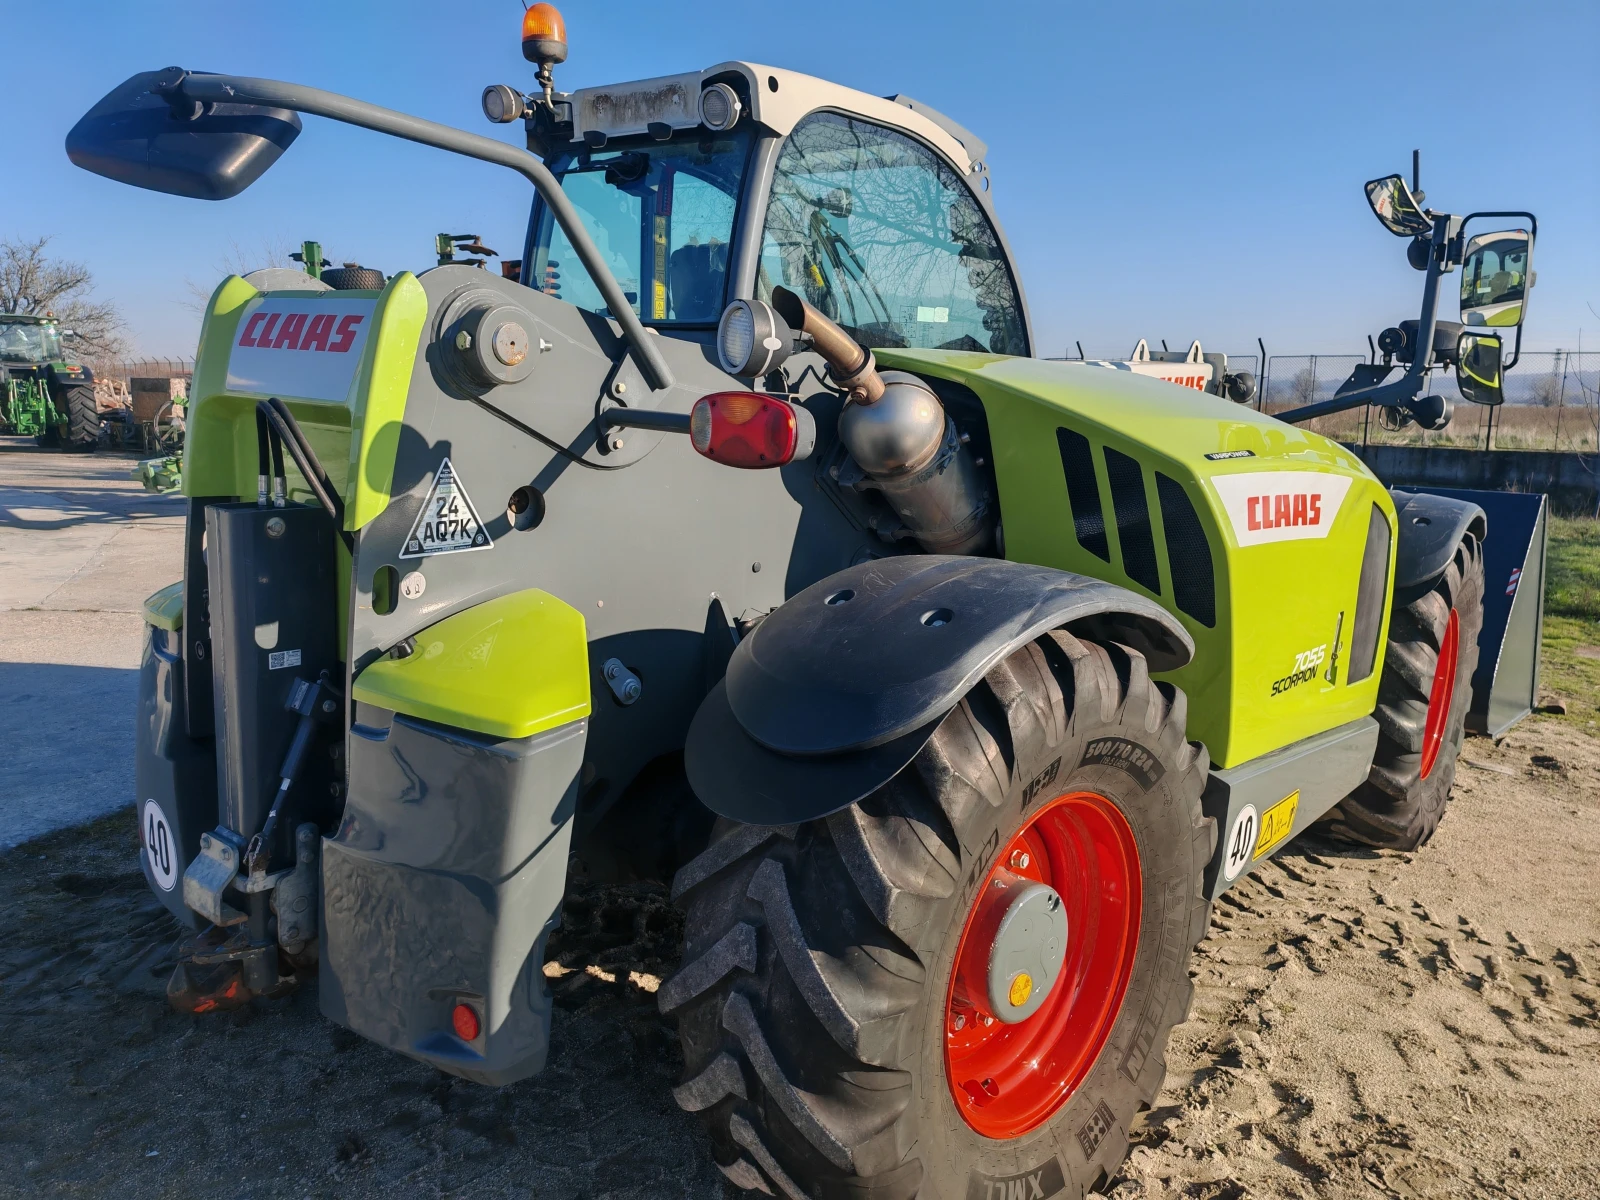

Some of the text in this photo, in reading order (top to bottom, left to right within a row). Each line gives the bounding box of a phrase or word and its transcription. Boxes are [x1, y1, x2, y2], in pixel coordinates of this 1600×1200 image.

[239, 312, 365, 353] CLAAS
[436, 496, 459, 519] 24
[1247, 493, 1322, 532] CLAAS
[423, 518, 472, 543] AQ7K
[1292, 643, 1327, 675] 7055
[1270, 664, 1319, 698] SCORPION
[1085, 740, 1133, 759] 500/70
[149, 812, 171, 877] 40
[1230, 815, 1253, 867] 40
[1126, 917, 1184, 1082] MICHELIN
